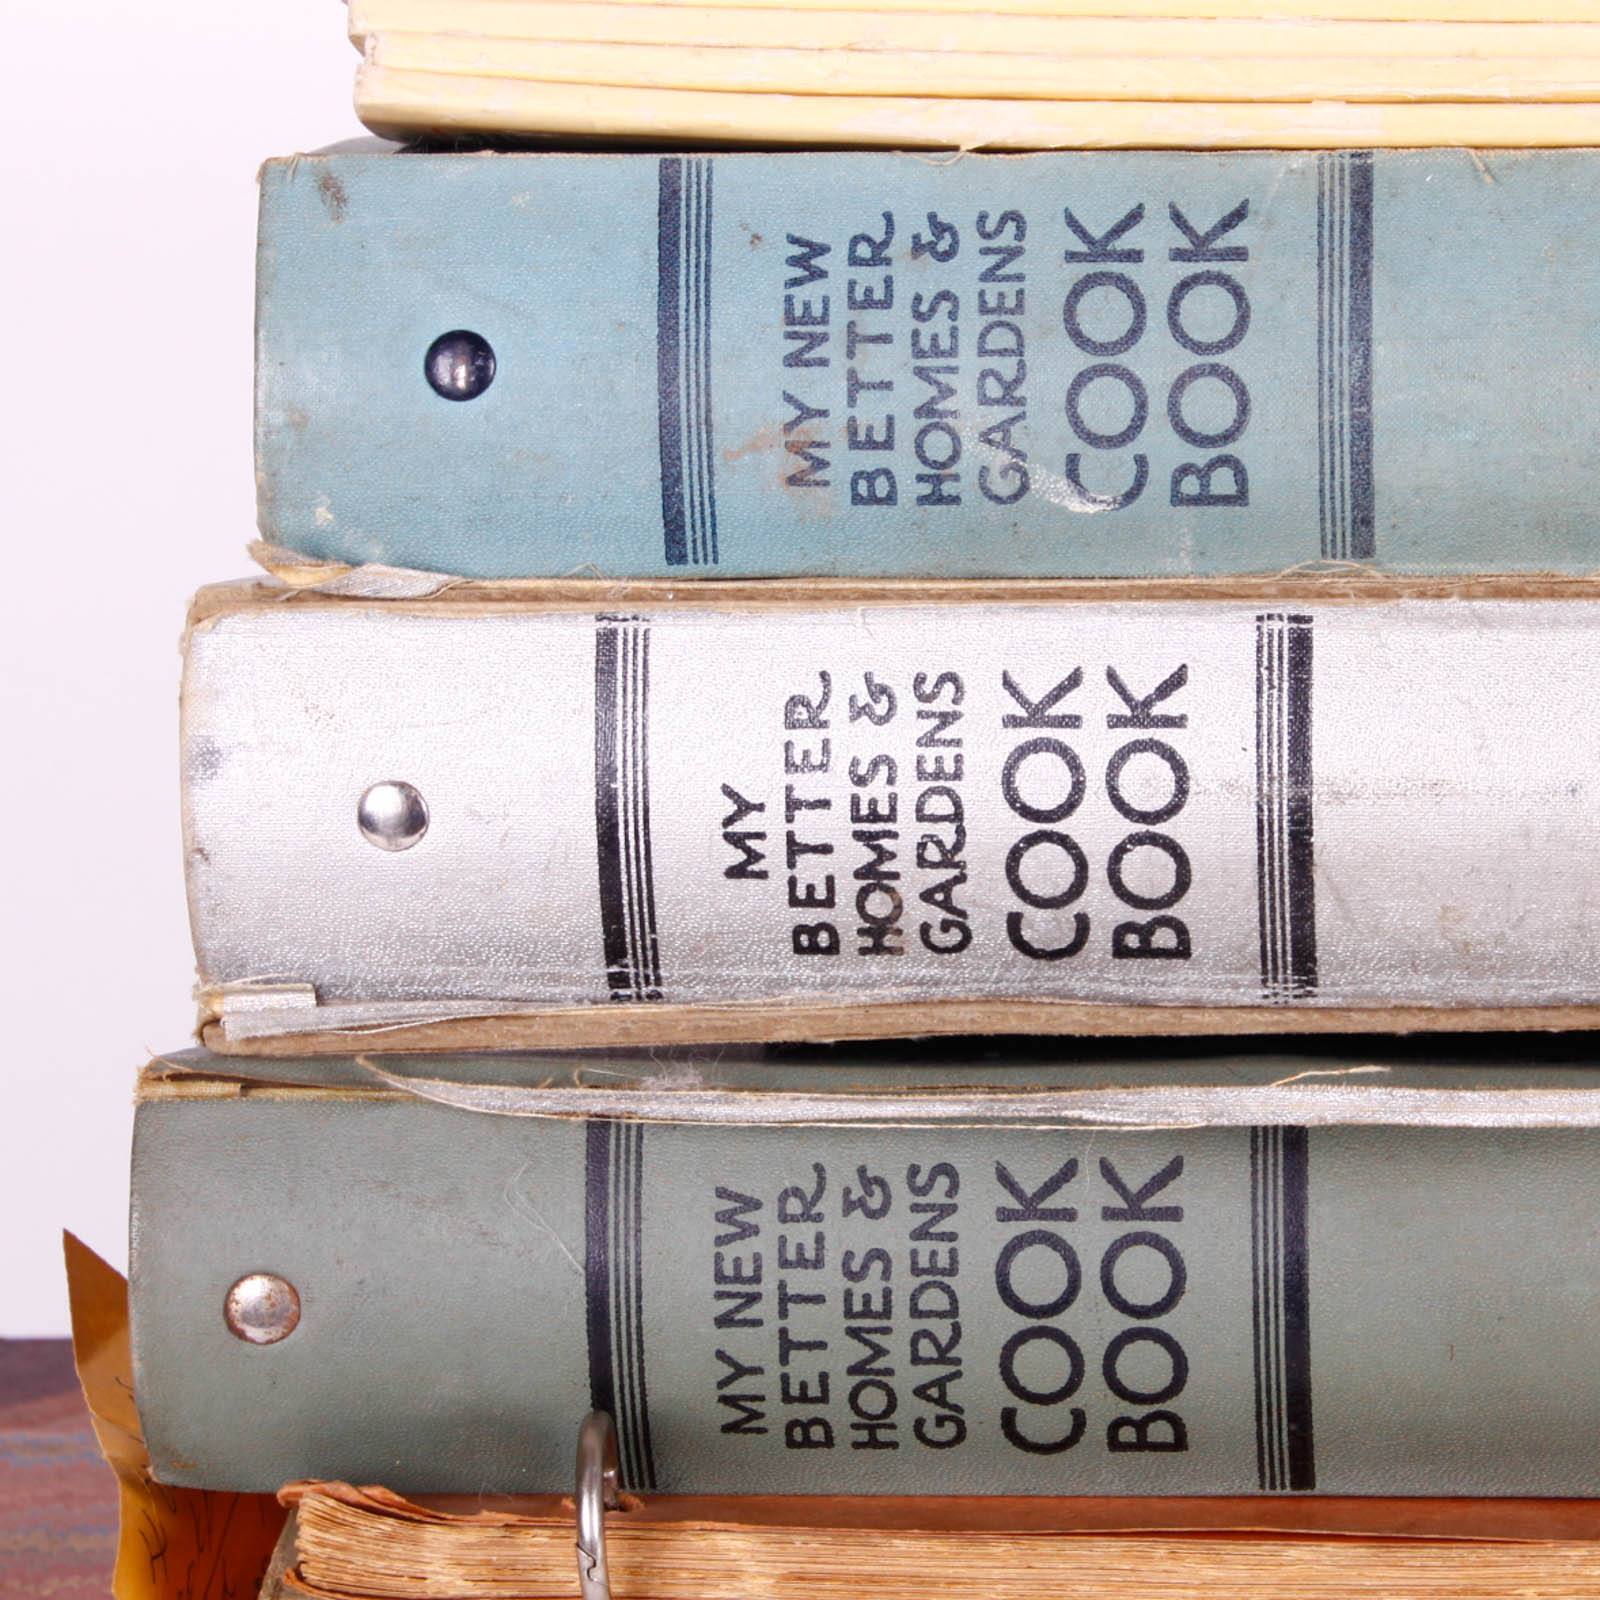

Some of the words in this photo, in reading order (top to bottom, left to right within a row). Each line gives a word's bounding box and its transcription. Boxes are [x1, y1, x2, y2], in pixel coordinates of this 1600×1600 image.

[783, 233, 831, 368] NEW
[847, 211, 897, 506] BETTER
[910, 212, 959, 263] &
[976, 209, 1030, 504] GARDENS
[1063, 202, 1149, 512] COOK
[1166, 199, 1251, 507] BOOK
[784, 392, 831, 488] MY
[911, 290, 961, 506] HOMES
[721, 783, 768, 880] MY
[784, 670, 839, 956] BETTER
[849, 671, 898, 726] &
[913, 671, 972, 955] GARDENS
[1002, 665, 1090, 960] COOK
[1105, 663, 1192, 960] BOOK
[849, 753, 903, 956] HOMES
[714, 1186, 764, 1329] NEW
[778, 1162, 835, 1450] BETTER
[842, 1165, 892, 1219] &
[906, 1162, 967, 1449] GARDENS
[995, 1157, 1087, 1454] COOK
[1099, 1155, 1189, 1453] BOOK
[715, 1350, 768, 1436] MY
[842, 1247, 899, 1450] HOMES
